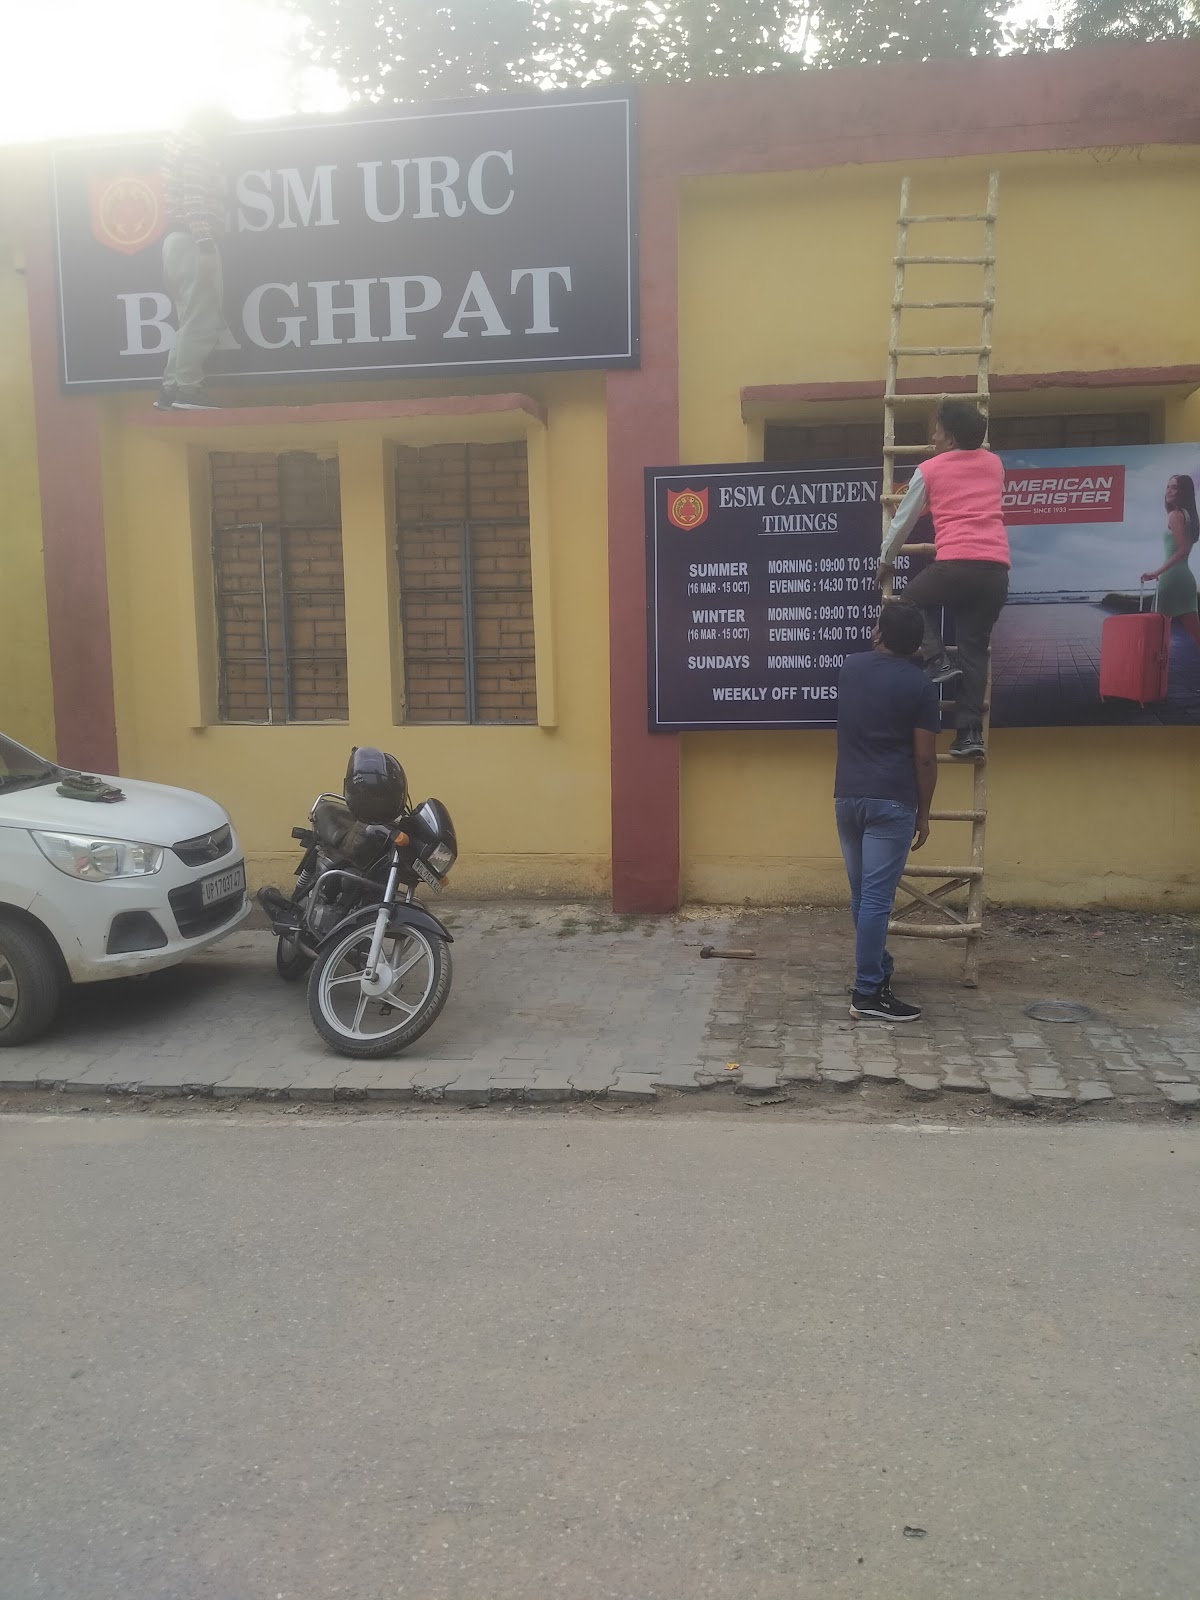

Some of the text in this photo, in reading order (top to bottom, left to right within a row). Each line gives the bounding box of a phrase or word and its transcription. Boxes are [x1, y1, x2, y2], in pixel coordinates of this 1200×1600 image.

[223, 150, 515, 232] SM URC
[719, 481, 878, 508] ESM CANTEEN
[1001, 491, 1111, 506] OURISTER
[762, 513, 838, 533] TIMINGS
[689, 563, 749, 578] SUMMER
[768, 559, 812, 574] MORNING
[820, 558, 845, 572] 09:00
[848, 557, 860, 571] TO
[863, 556, 881, 571] 13:0
[687, 582, 699, 597] (16
[700, 583, 717, 594] MAR
[722, 582, 731, 593] 15
[733, 580, 750, 595] OCT)
[769, 579, 811, 594] EVENING
[819, 578, 844, 592] 14:30
[846, 577, 859, 591] TO
[692, 609, 745, 623] WINTER
[768, 606, 812, 621] MORNING
[819, 605, 845, 620] 09:00
[847, 605, 860, 619] TO
[862, 604, 882, 619] 13:0
[687, 628, 699, 643] (16
[700, 629, 717, 640] MAR
[722, 628, 731, 640] 15
[732, 627, 750, 642] OCT)
[769, 627, 810, 642] EVENING
[818, 626, 843, 641] 14:00
[845, 626, 858, 640] TO
[687, 655, 750, 670] SUNDAYS
[768, 654, 812, 669] MORNING
[819, 653, 844, 668] 09:00
[712, 686, 838, 701] WEEKLY OFF TUES
